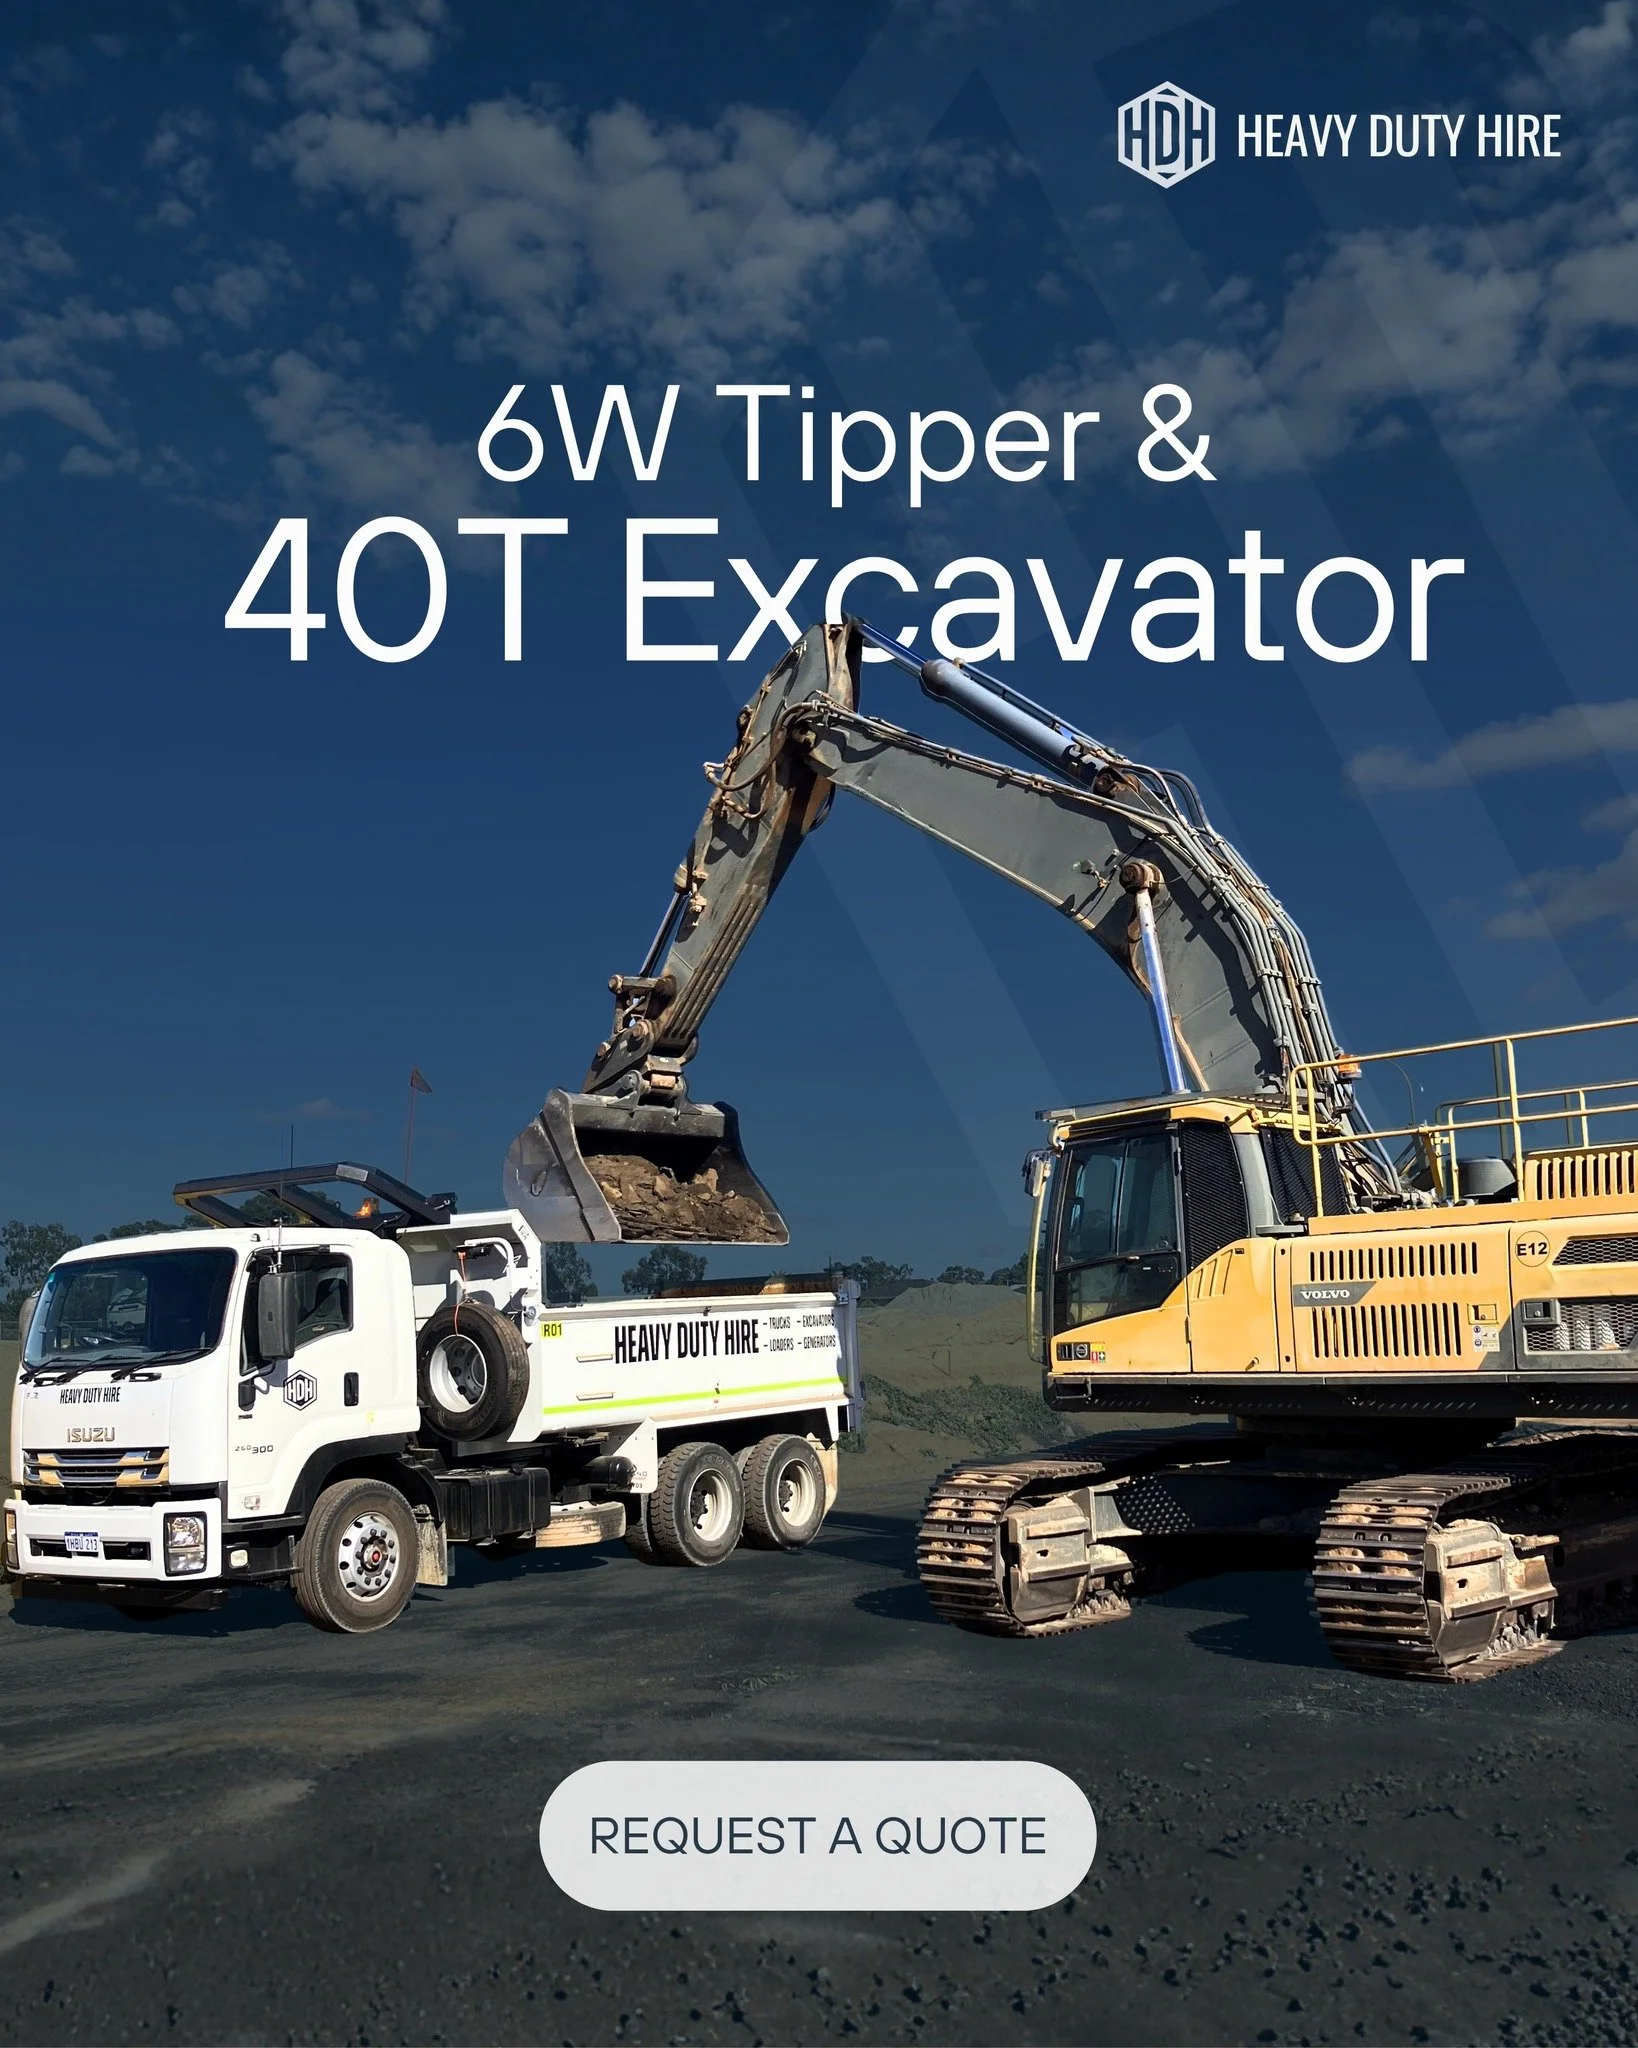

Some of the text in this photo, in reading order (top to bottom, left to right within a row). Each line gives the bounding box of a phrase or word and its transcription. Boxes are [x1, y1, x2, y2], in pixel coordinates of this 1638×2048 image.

[1517, 1242, 1547, 1256] E12
[1300, 1289, 1350, 1300] VOLVO
[543, 1323, 563, 1337] R01
[615, 1319, 760, 1364] HEAVY DUTY HIRE
[60, 1387, 121, 1404] HEAVY DUTY HIRE
[67, 1427, 116, 1442] ISUZU
